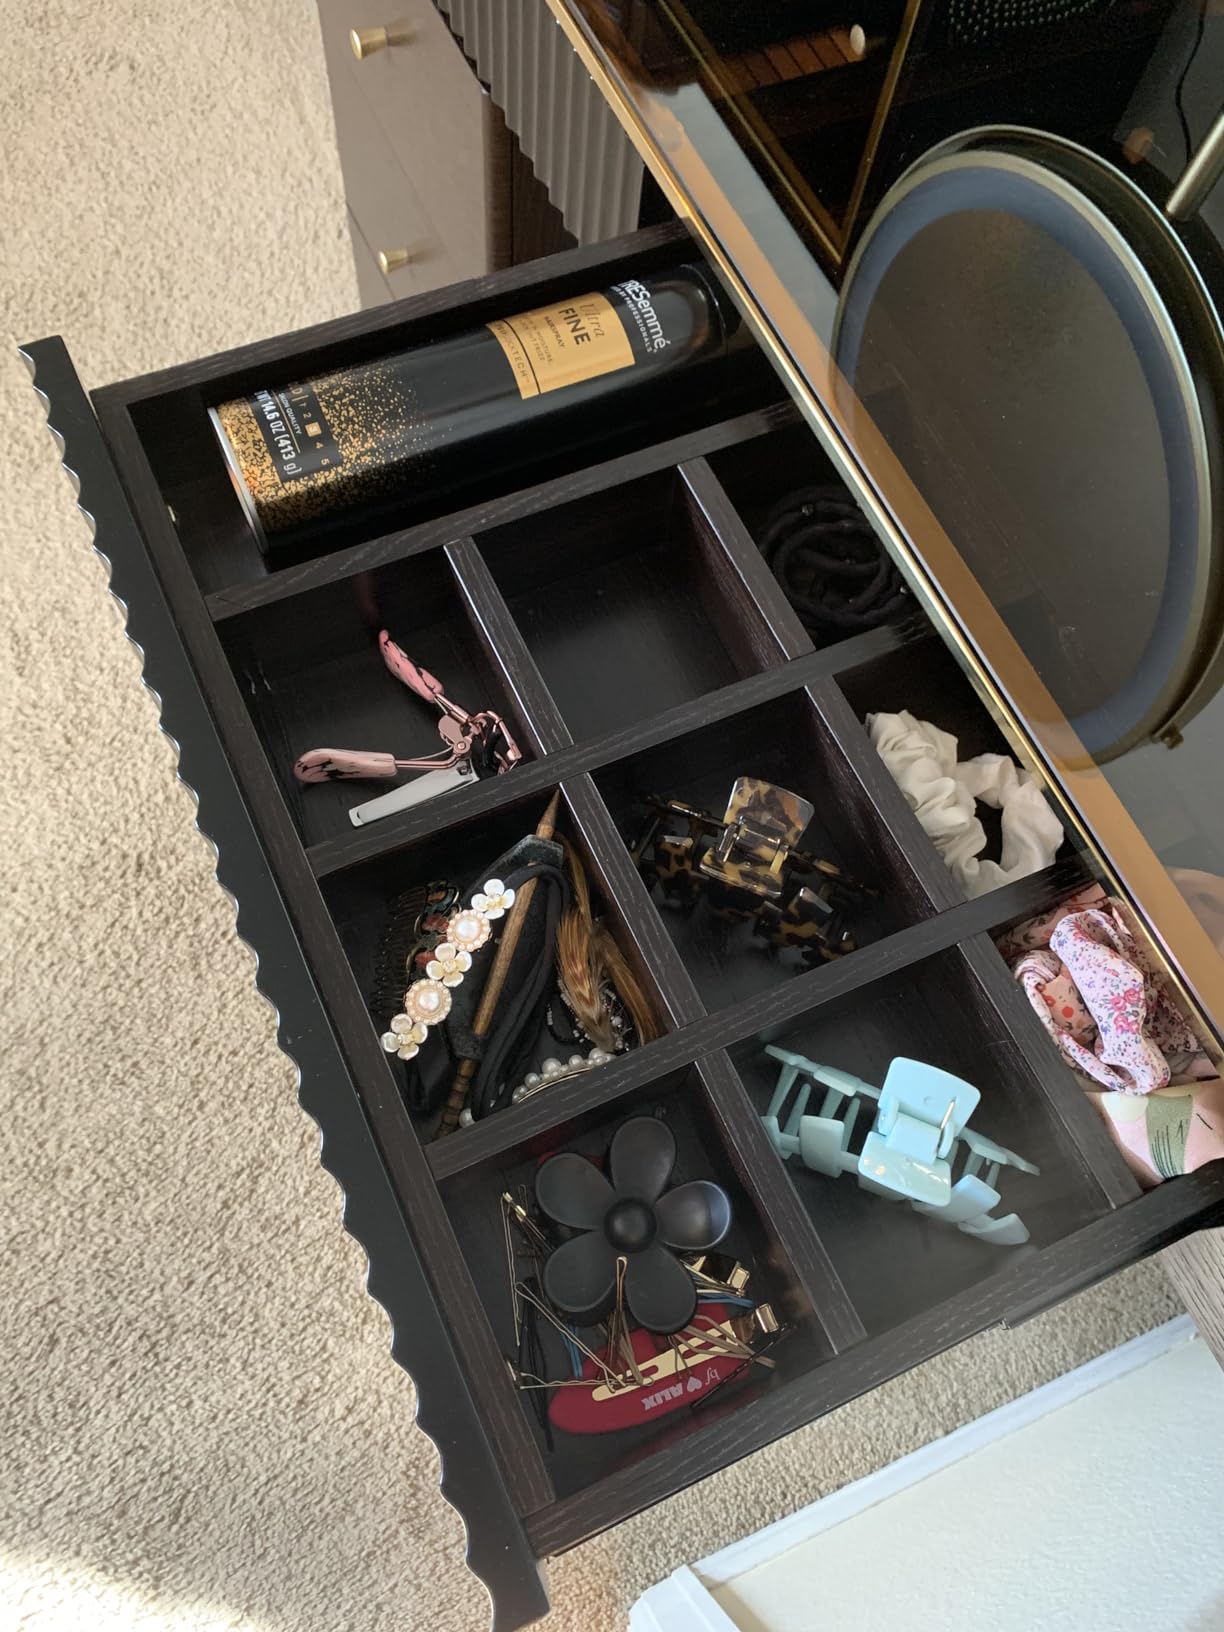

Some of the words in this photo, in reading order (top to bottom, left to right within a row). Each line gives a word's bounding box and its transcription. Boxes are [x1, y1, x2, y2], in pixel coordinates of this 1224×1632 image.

[544, 316, 566, 348] HAIRSPRAY
[558, 307, 591, 345] FINE
[579, 303, 605, 338] Ultra
[624, 297, 652, 353] PROFESSIONALS
[261, 401, 280, 420] 14.6
[286, 407, 302, 435] QUALITY
[269, 420, 286, 434] OZ
[274, 433, 296, 460] (413
[283, 462, 302, 475] g)
[641, 1383, 684, 1411] ALIX
